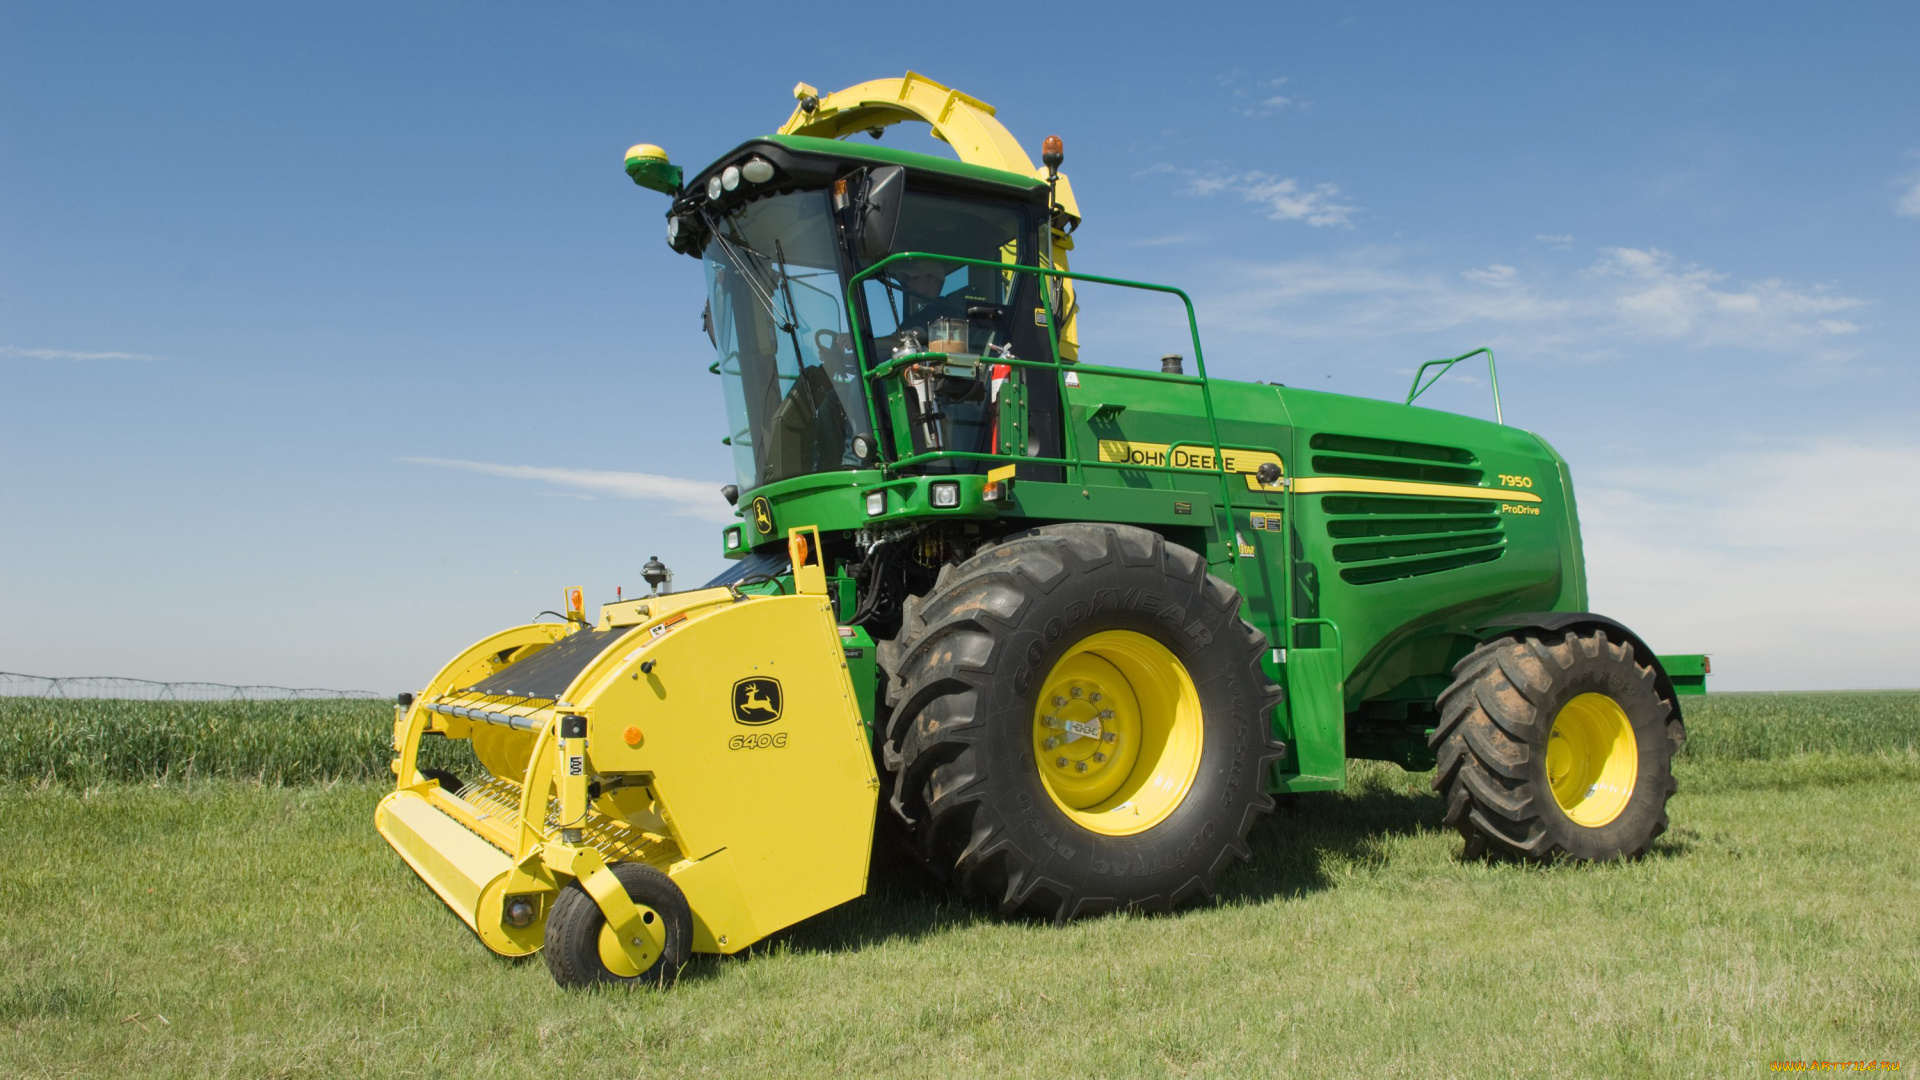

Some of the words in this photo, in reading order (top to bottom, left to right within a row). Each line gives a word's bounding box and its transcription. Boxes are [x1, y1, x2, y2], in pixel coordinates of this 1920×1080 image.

[1498, 475, 1532, 488] 7950
[1502, 504, 1540, 515] ProDrive
[1013, 587, 1214, 697] GOODYEAR
[729, 733, 787, 750] 640C
